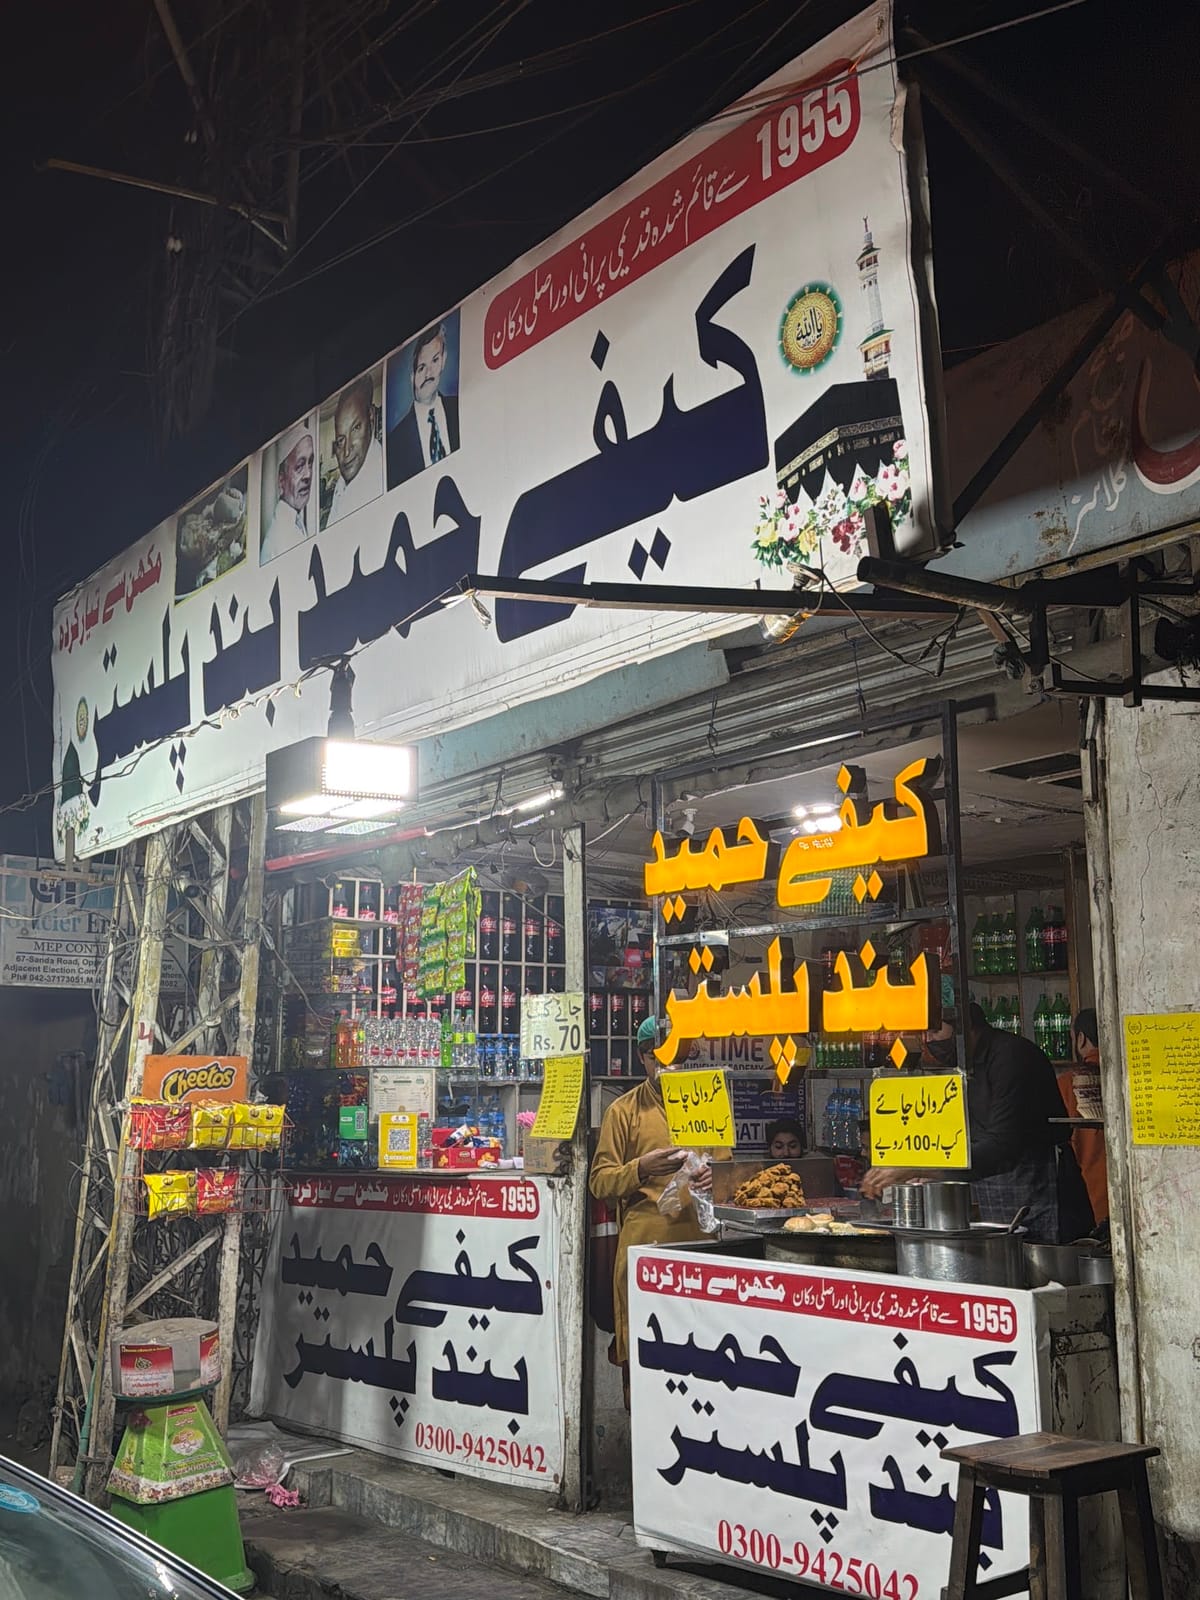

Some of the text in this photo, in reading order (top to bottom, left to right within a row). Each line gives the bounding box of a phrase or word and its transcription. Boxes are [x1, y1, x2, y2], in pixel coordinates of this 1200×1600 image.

[756, 83, 853, 182] 1955
[714, 170, 751, 204] سے
[651, 189, 684, 248] شدہ
[574, 242, 607, 304] پرانی
[524, 269, 552, 336] اصلی
[551, 269, 574, 313] اور
[490, 297, 523, 358] دکان
[495, 242, 769, 643] کیفے
[125, 543, 162, 614] مکھن
[102, 570, 126, 625] سے
[59, 598, 80, 655] کردہ
[202, 575, 281, 728] بند
[88, 603, 191, 808] پلستر
[643, 757, 930, 925] کیفے حمید
[33, 941, 63, 952] MEP
[3, 964, 44, 975] Adjacent
[43, 965, 77, 975] Election
[652, 935, 930, 1086] بند پلستر
[533, 1024, 581, 1052] Rs. 70
[704, 1037, 764, 1062] TIME
[162, 1062, 236, 1101] Cheetos
[666, 1085, 690, 1112] چائے
[691, 1080, 709, 1106] والی
[710, 1073, 723, 1103] شکر
[875, 1078, 958, 1126] شکر والی چائے
[671, 1123, 688, 1140] روپے
[715, 1115, 731, 1139] کپ
[875, 1137, 904, 1159] روپے
[941, 1129, 963, 1160] کپ
[288, 1178, 312, 1204] کرد
[333, 1181, 357, 1203] سے
[486, 1197, 500, 1209] سے
[499, 1185, 537, 1213] 1955
[281, 1228, 544, 1331] کیفے حمید
[641, 1263, 675, 1290] کردہ
[674, 1264, 703, 1294] تیار
[706, 1273, 737, 1296] سے
[737, 1273, 786, 1303] مکھن
[792, 1282, 815, 1308] دکان
[815, 1278, 835, 1311] اصلی
[834, 1293, 849, 1310] اور
[850, 1285, 872, 1322] پرانی
[899, 1298, 919, 1320] شدہ
[937, 1306, 959, 1325] سے
[960, 1300, 1014, 1336] 1955
[283, 1306, 529, 1437] بند پلستر
[637, 1312, 1020, 1449] کیفے حمید
[415, 1421, 547, 1473] 0300-9425042
[656, 1398, 1003, 1571] بند پلستر
[718, 1519, 919, 1600] 0300-9425042
